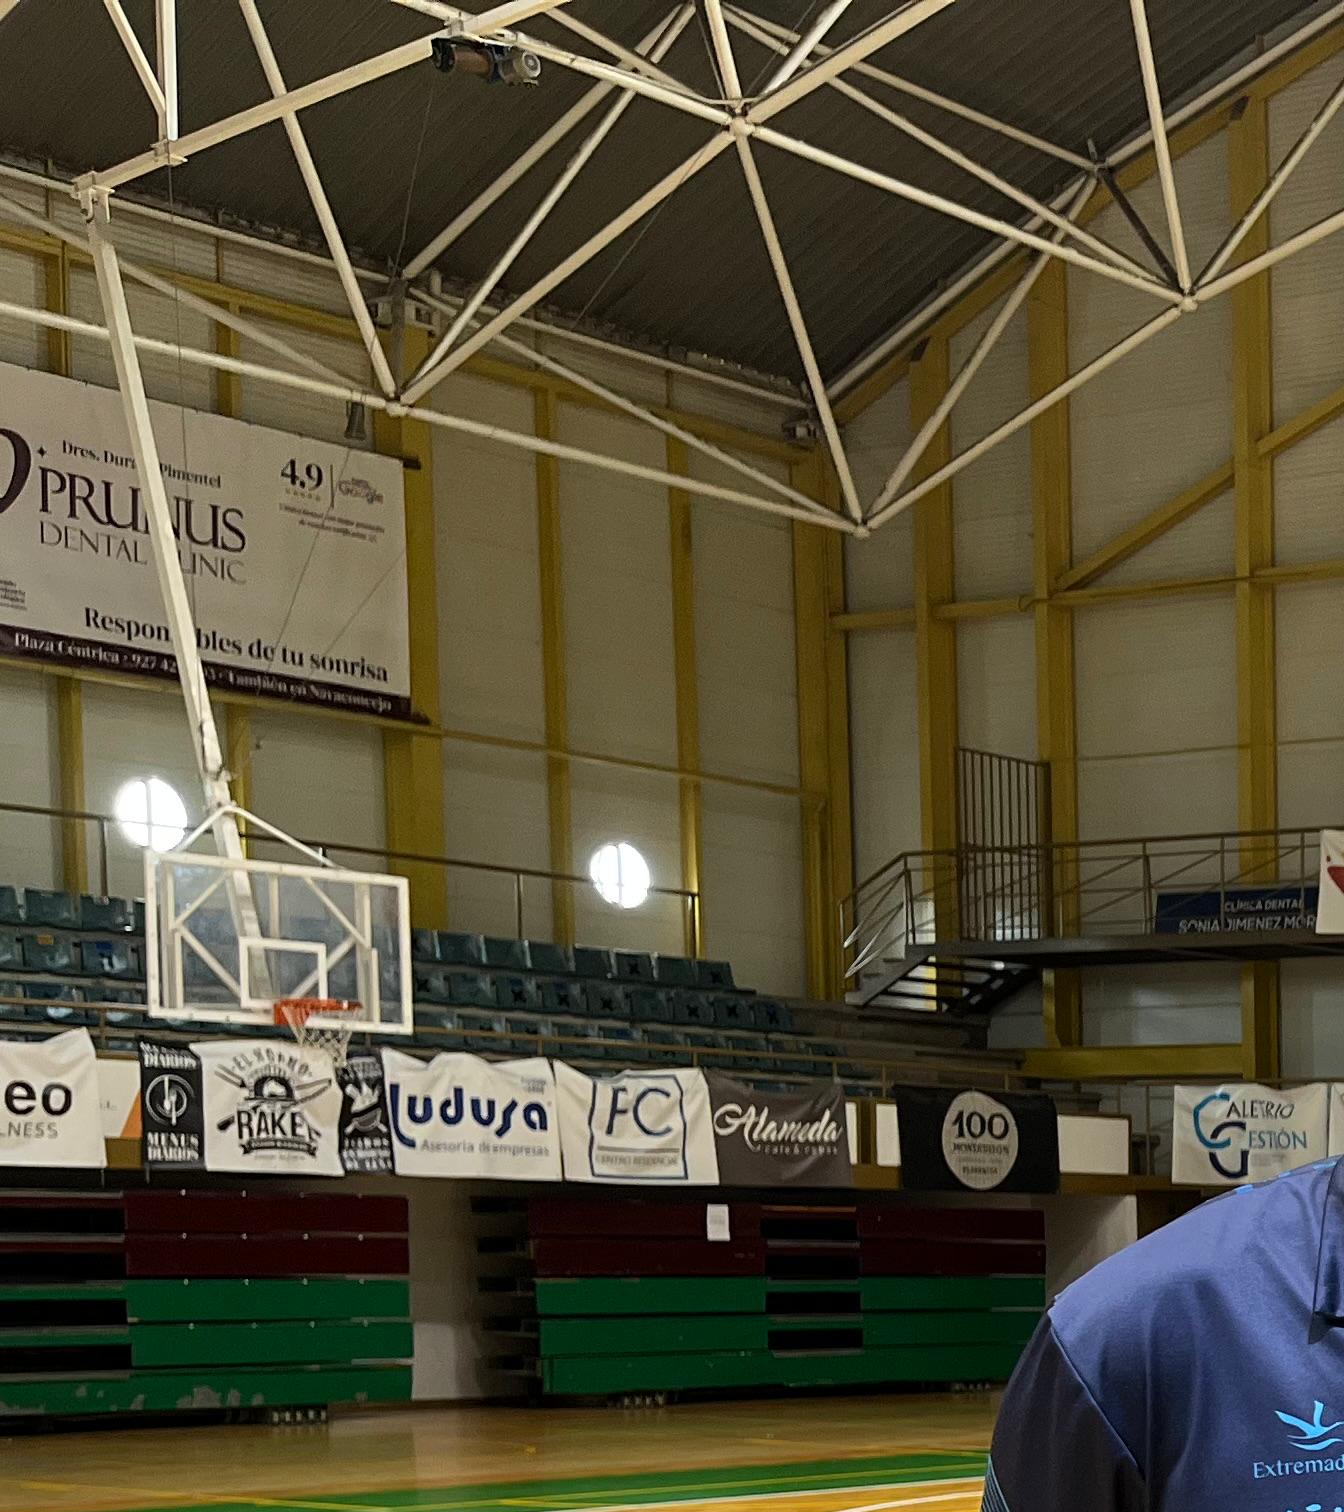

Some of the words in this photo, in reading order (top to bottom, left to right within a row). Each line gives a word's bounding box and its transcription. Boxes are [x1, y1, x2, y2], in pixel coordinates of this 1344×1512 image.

[40, 519, 148, 566] DENTAL
[178, 550, 247, 585] LINIC
[84, 606, 244, 657] Responbles
[248, 638, 275, 662] de
[280, 644, 305, 668] tu
[309, 651, 389, 683] sonrisa
[0, 1120, 59, 1140] NESS
[605, 1086, 674, 1137] FC
[713, 1103, 844, 1153] Alameda
[952, 1109, 1010, 1140] 100
